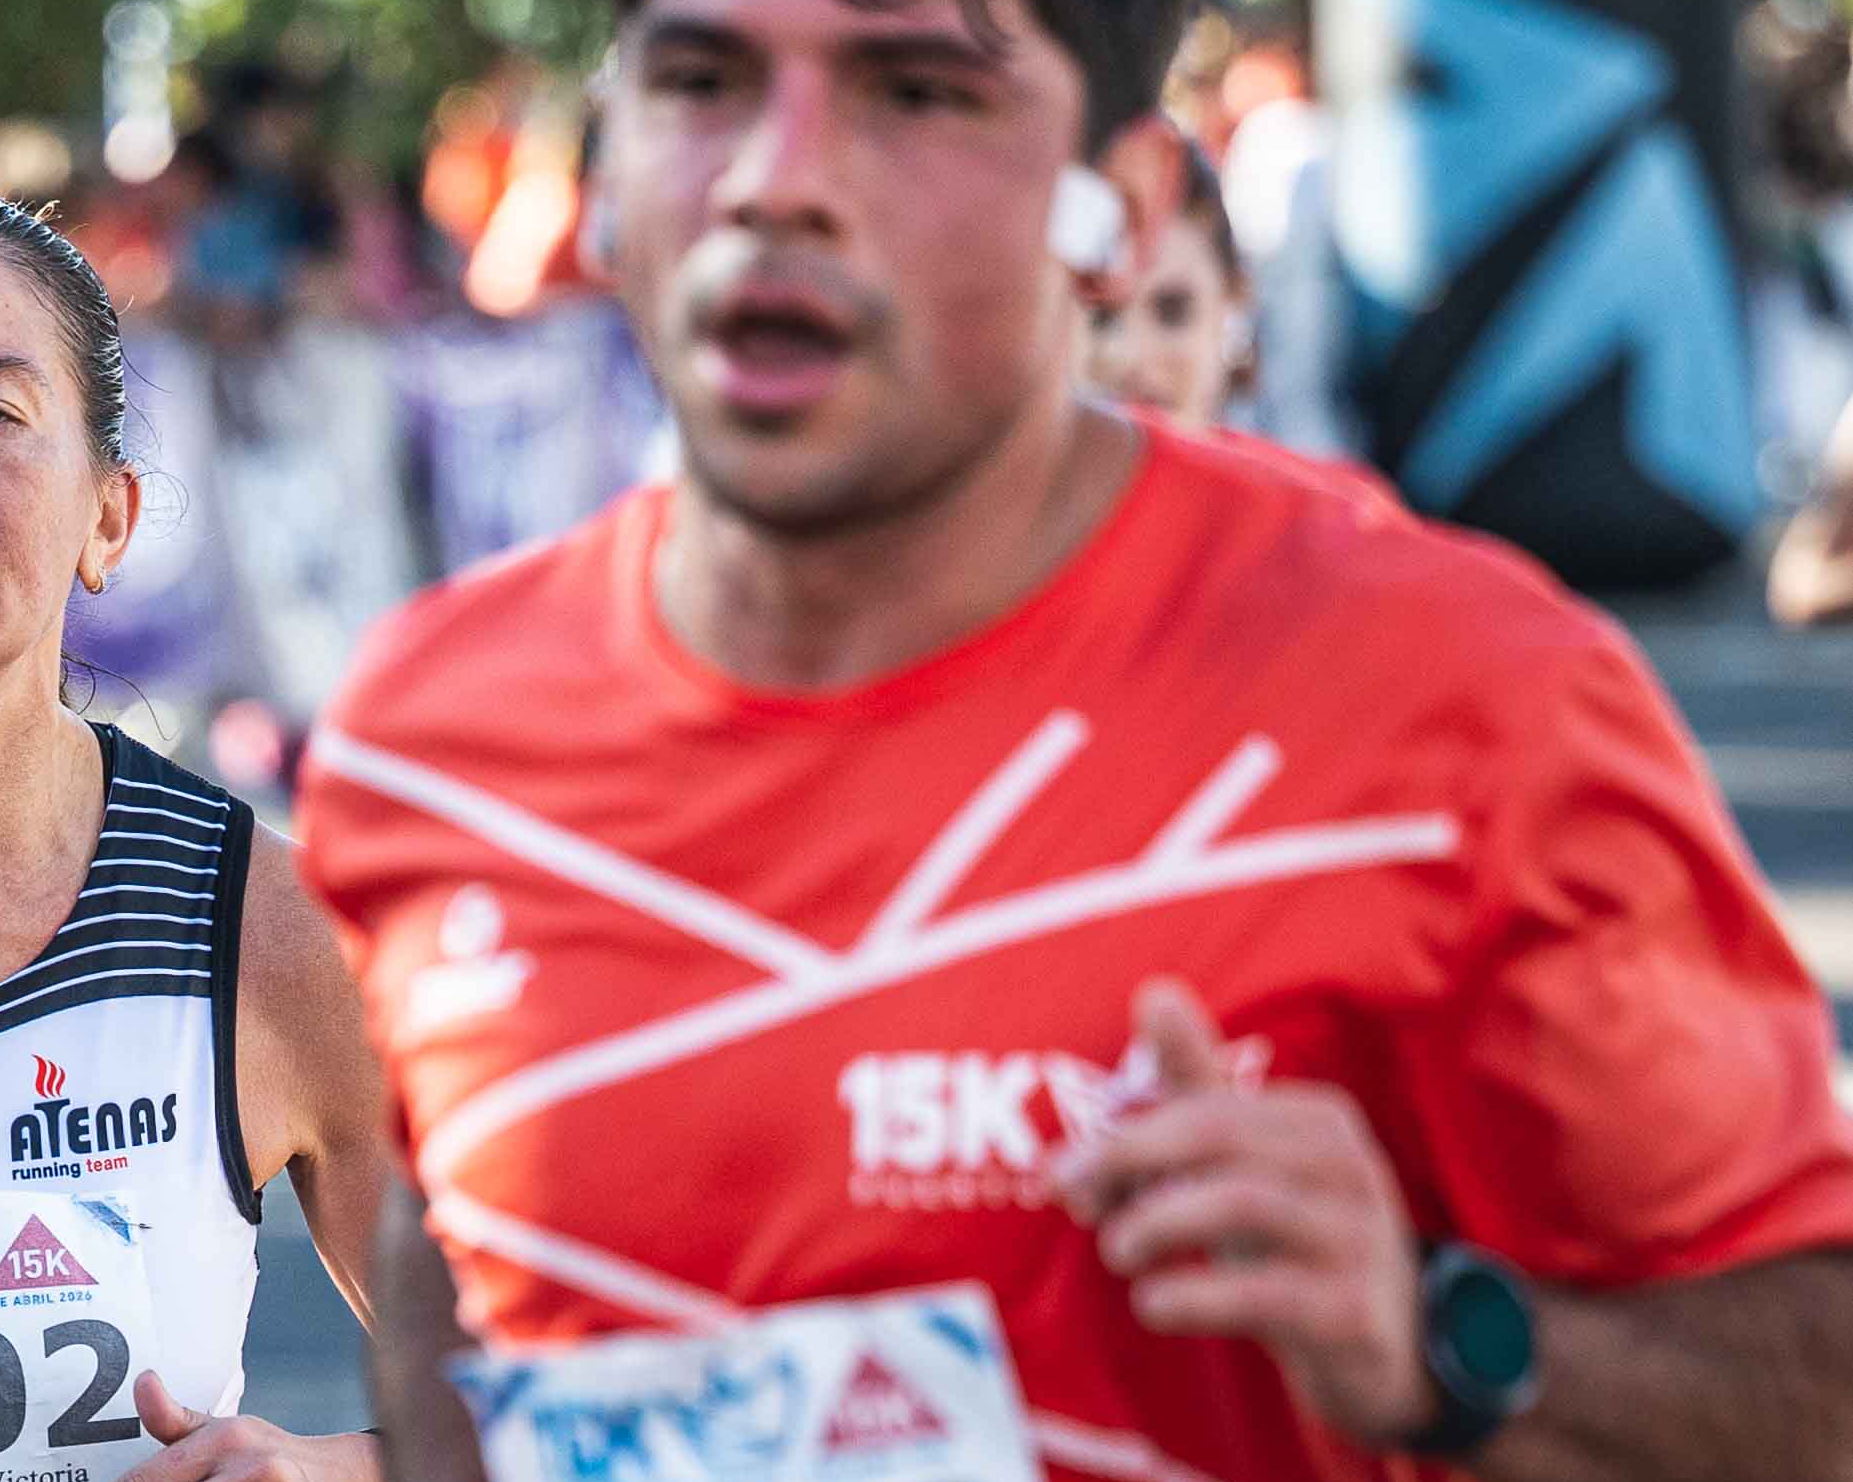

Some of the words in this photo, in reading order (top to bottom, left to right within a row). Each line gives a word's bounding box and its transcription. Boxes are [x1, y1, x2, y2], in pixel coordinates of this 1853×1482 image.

[838, 1050, 1042, 1171] 15K
[12, 1162, 81, 1181] running
[86, 1156, 128, 1173] team
[7, 1248, 71, 1281] 15K
[13, 1293, 53, 1306] ABRIL
[59, 1290, 93, 1303] 2026
